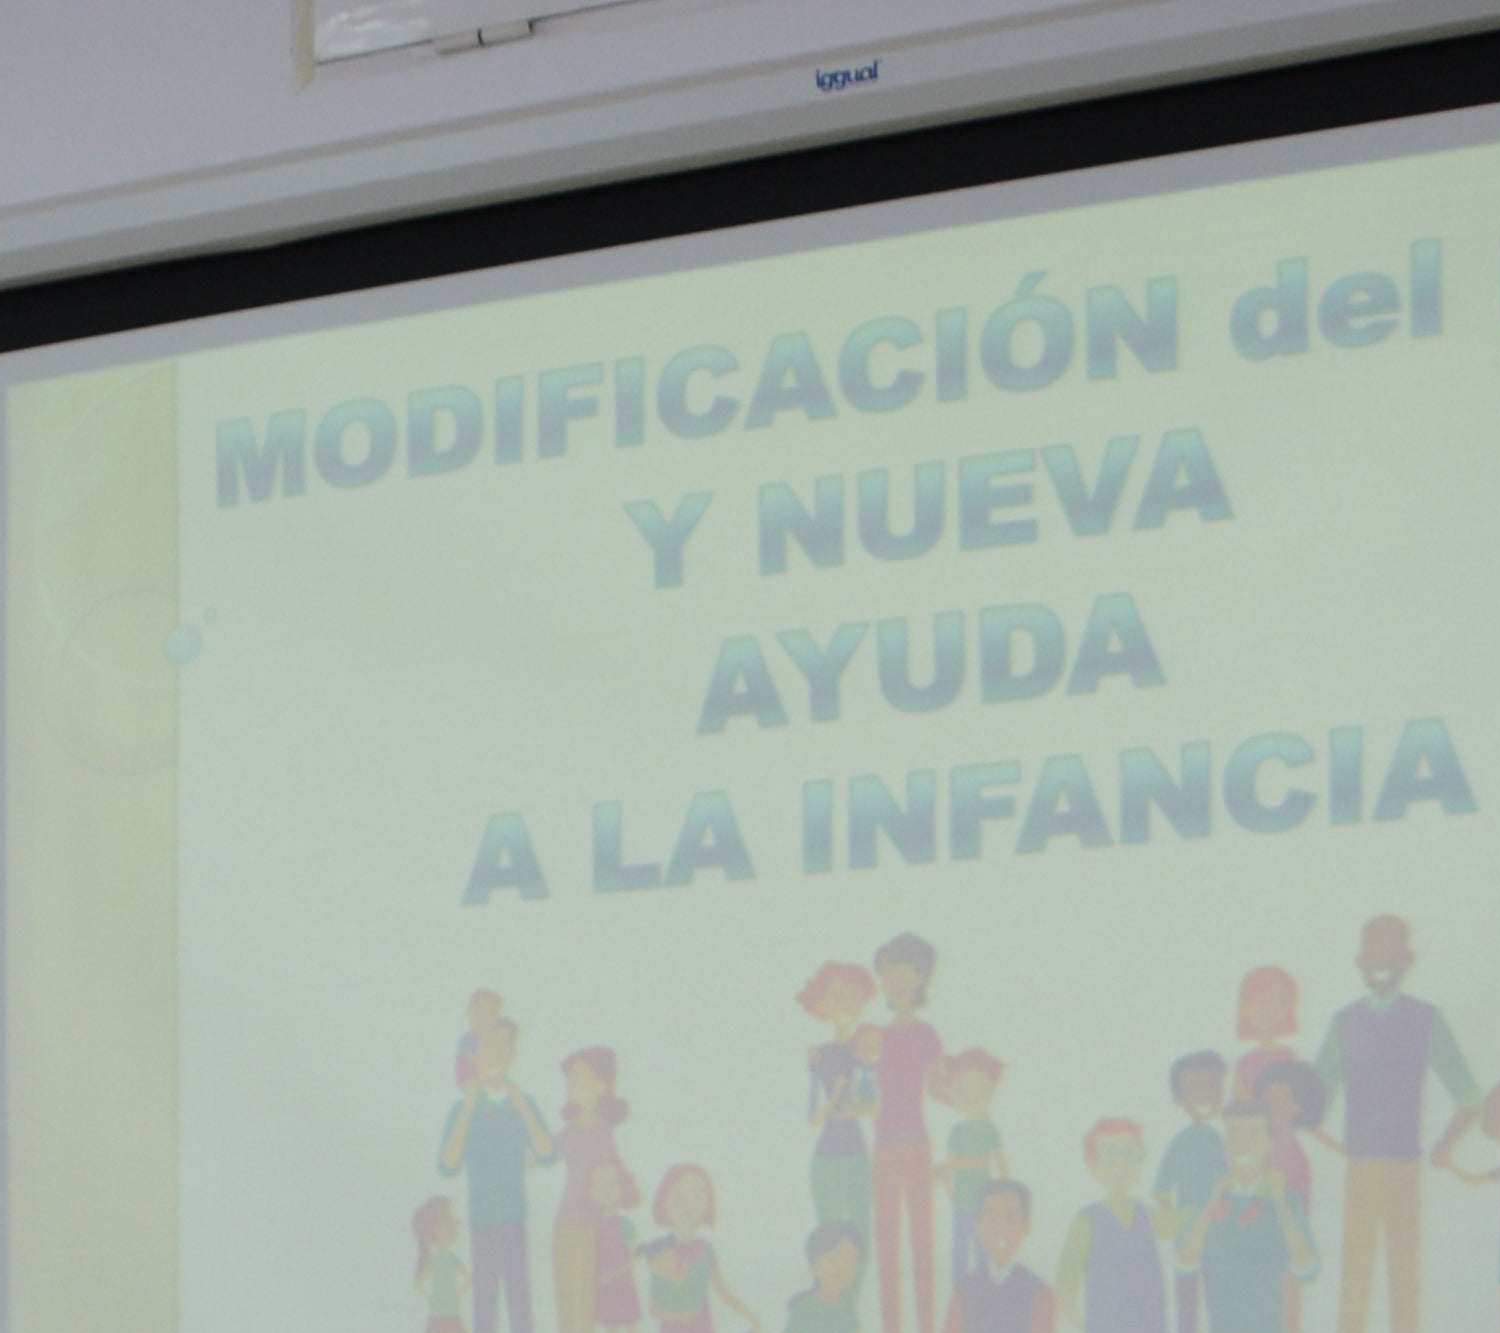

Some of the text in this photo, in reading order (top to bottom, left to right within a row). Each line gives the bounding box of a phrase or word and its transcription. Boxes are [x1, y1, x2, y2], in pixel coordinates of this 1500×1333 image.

[213, 270, 1180, 505] MODIFICACIÓN
[1228, 238, 1443, 360] del
[622, 428, 1235, 590] Y NUEVA
[695, 590, 1166, 735] AYUDA
[461, 716, 1477, 908] A LA INFANCIA
